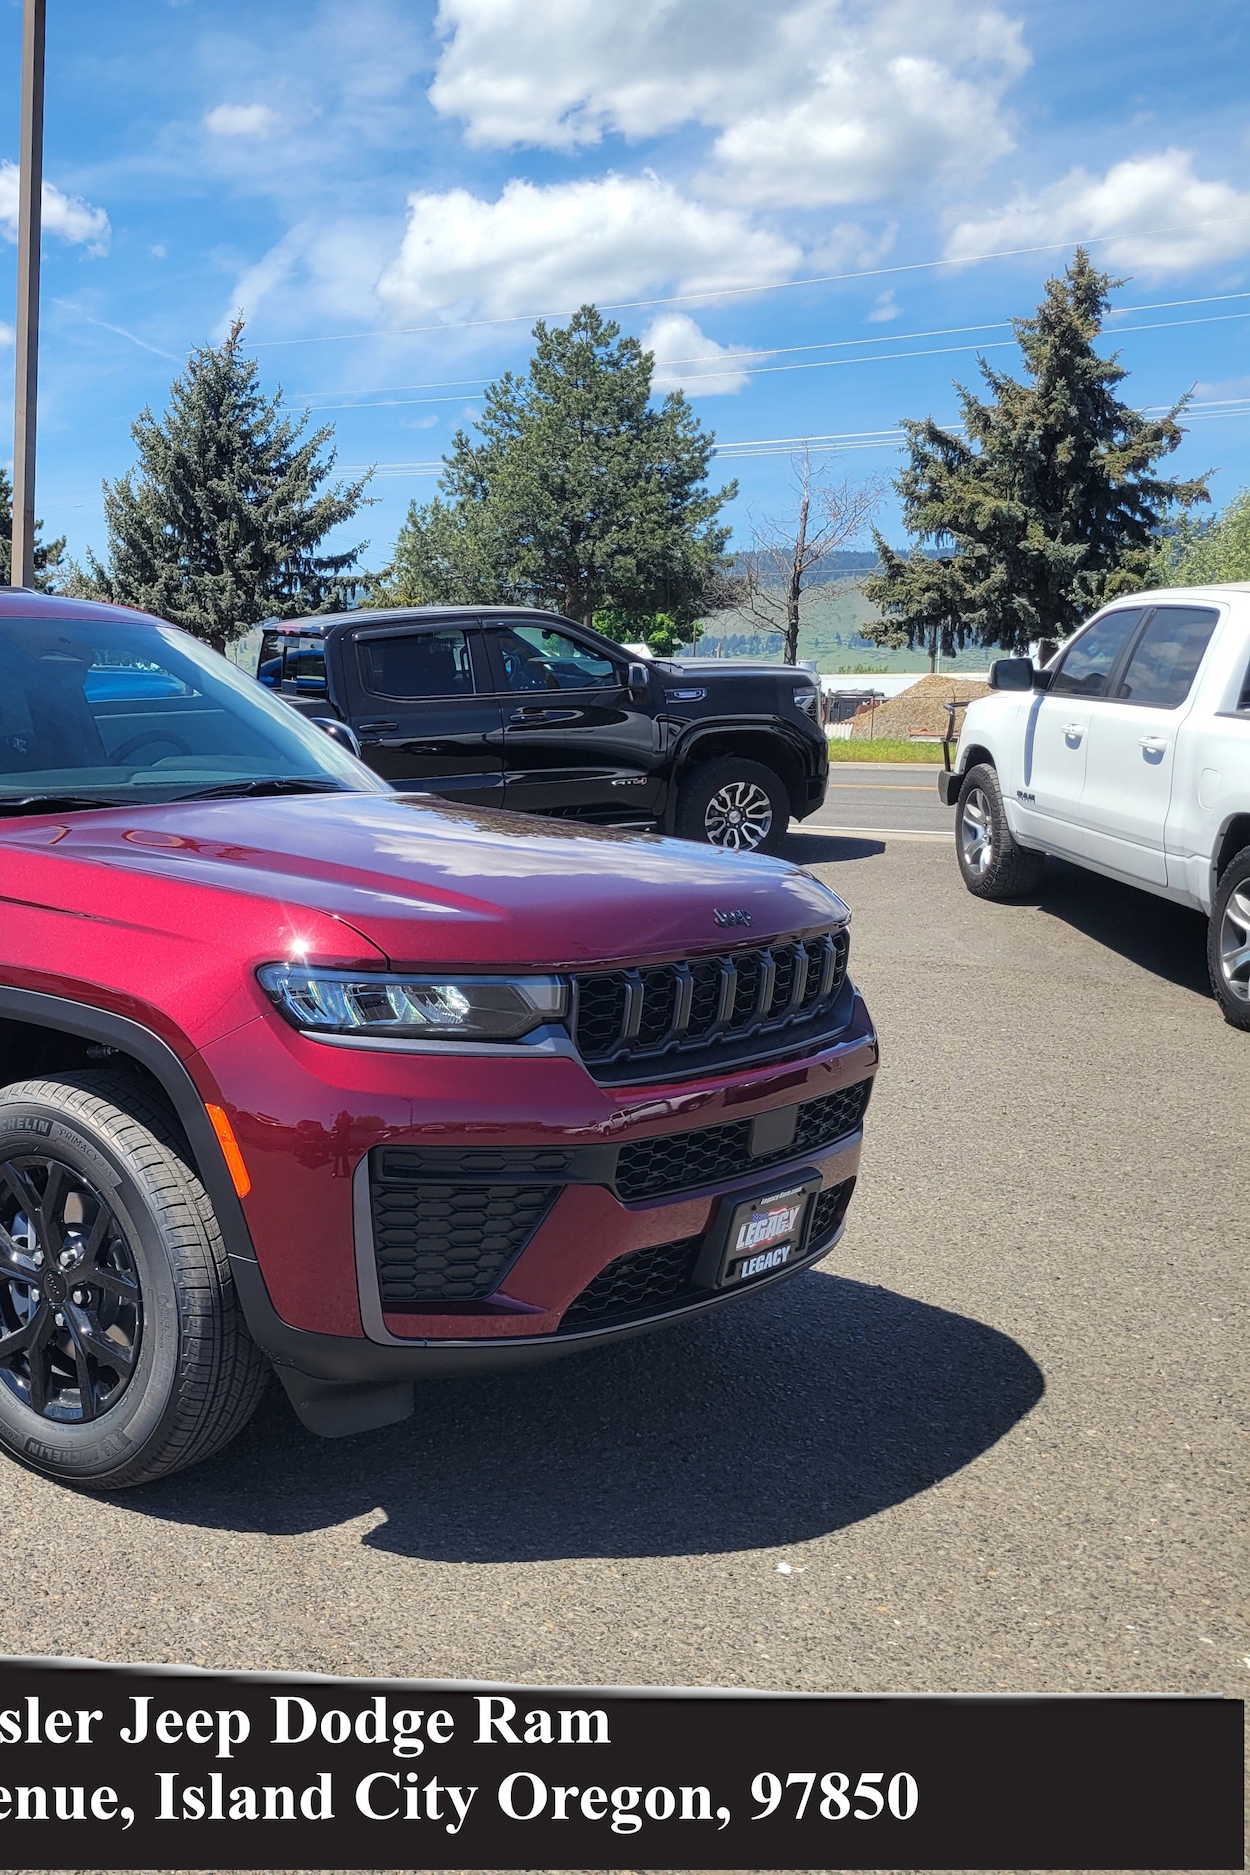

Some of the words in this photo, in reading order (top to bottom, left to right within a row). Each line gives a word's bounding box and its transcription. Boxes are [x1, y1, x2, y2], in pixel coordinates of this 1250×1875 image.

[59, 1127, 99, 1162] PRIMACY
[736, 1206, 800, 1250] LEGACY
[741, 1245, 791, 1278] LEGACY
